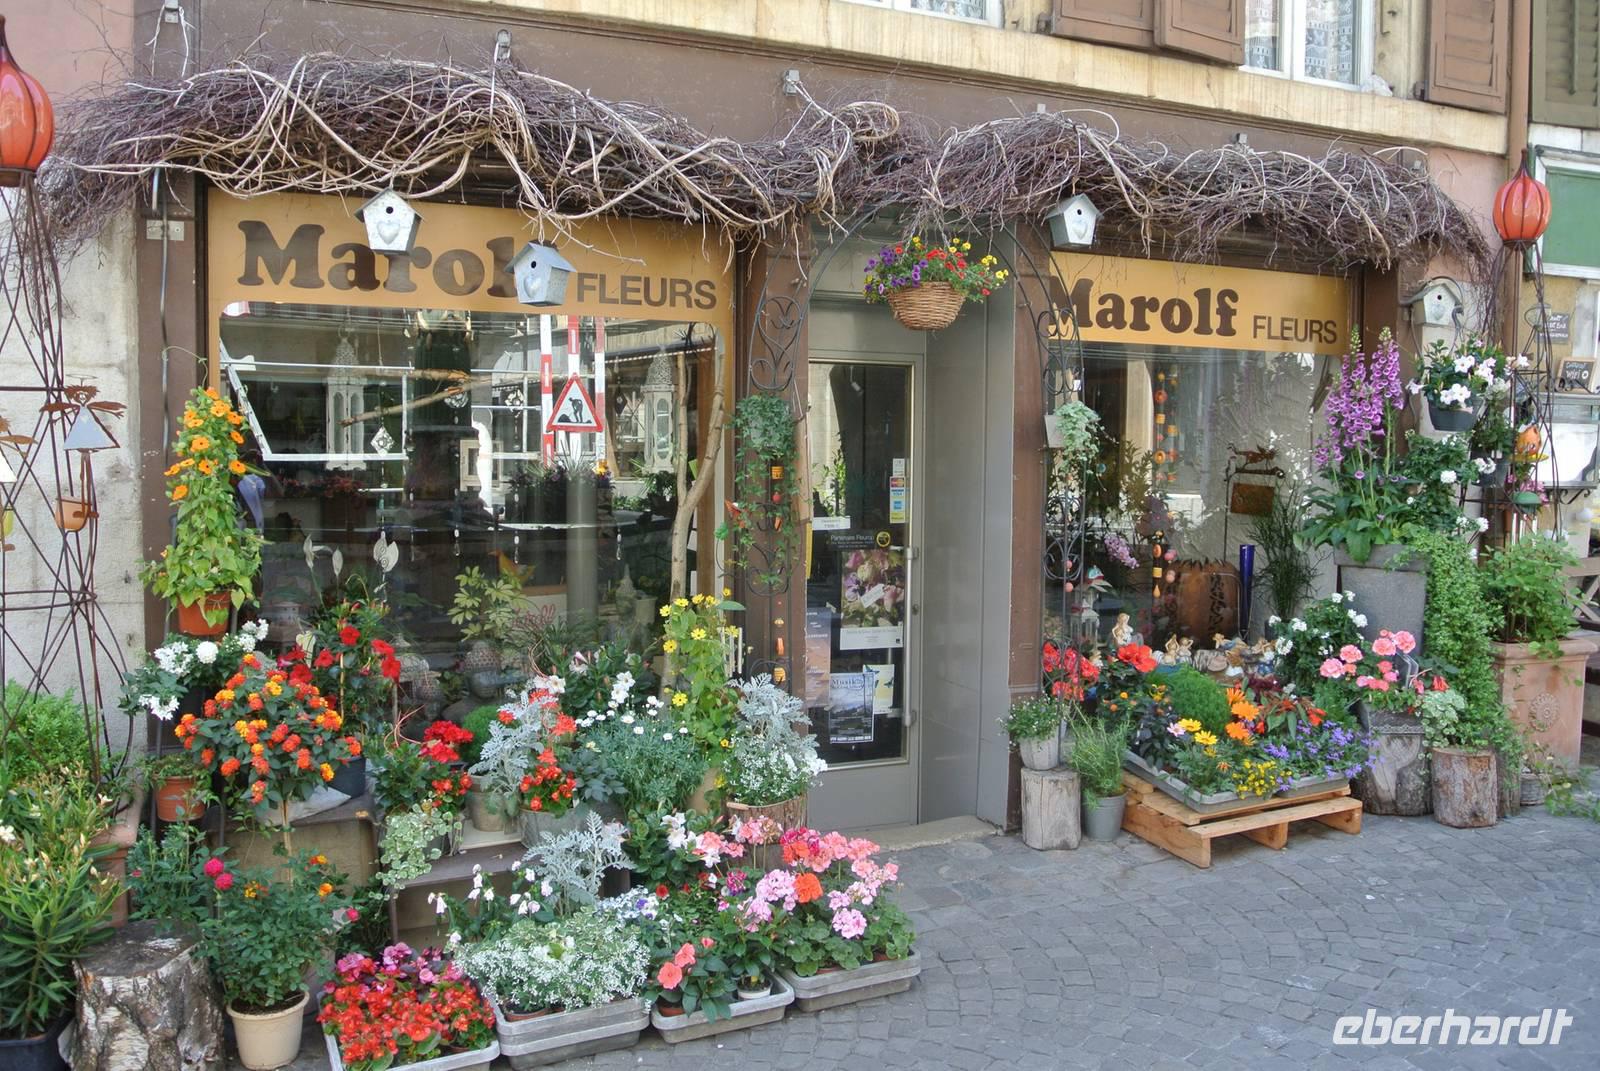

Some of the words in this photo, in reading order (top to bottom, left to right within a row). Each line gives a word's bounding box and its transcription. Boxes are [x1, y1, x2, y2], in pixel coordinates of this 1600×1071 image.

[238, 220, 556, 299] Marol
[577, 272, 716, 310] FLEURS
[1048, 275, 1239, 337] Marolf
[1253, 314, 1337, 344] FLEURS
